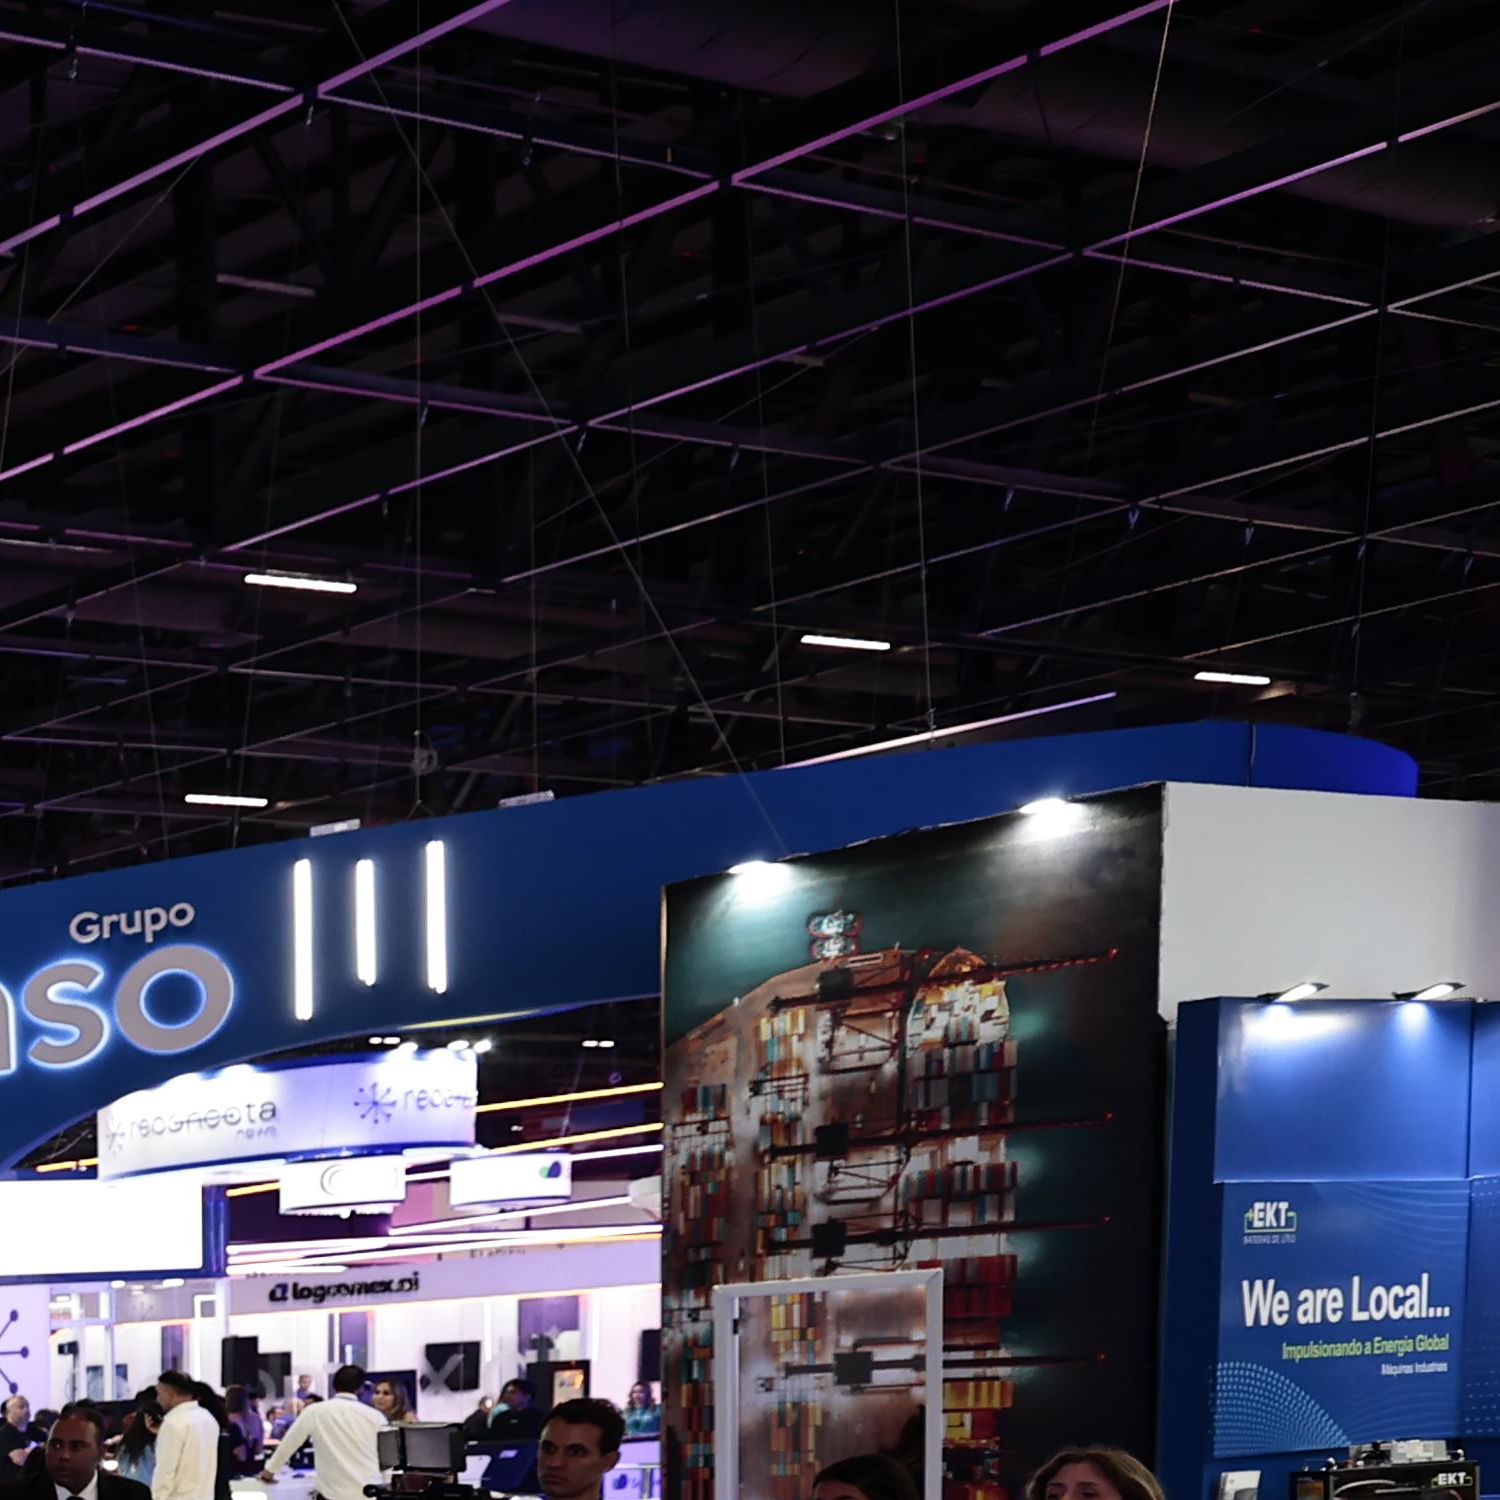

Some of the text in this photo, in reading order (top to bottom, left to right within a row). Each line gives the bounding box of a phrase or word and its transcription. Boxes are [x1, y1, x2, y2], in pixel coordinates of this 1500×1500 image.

[68, 900, 195, 944] Grupo
[1253, 1201, 1289, 1229] EKT
[1242, 1272, 1451, 1328] We are Local...
[1282, 1338, 1363, 1364] Impulsionando
[1373, 1335, 1414, 1358] Energia
[1415, 1333, 1450, 1352] Global
[1437, 1471, 1467, 1487] EKT
